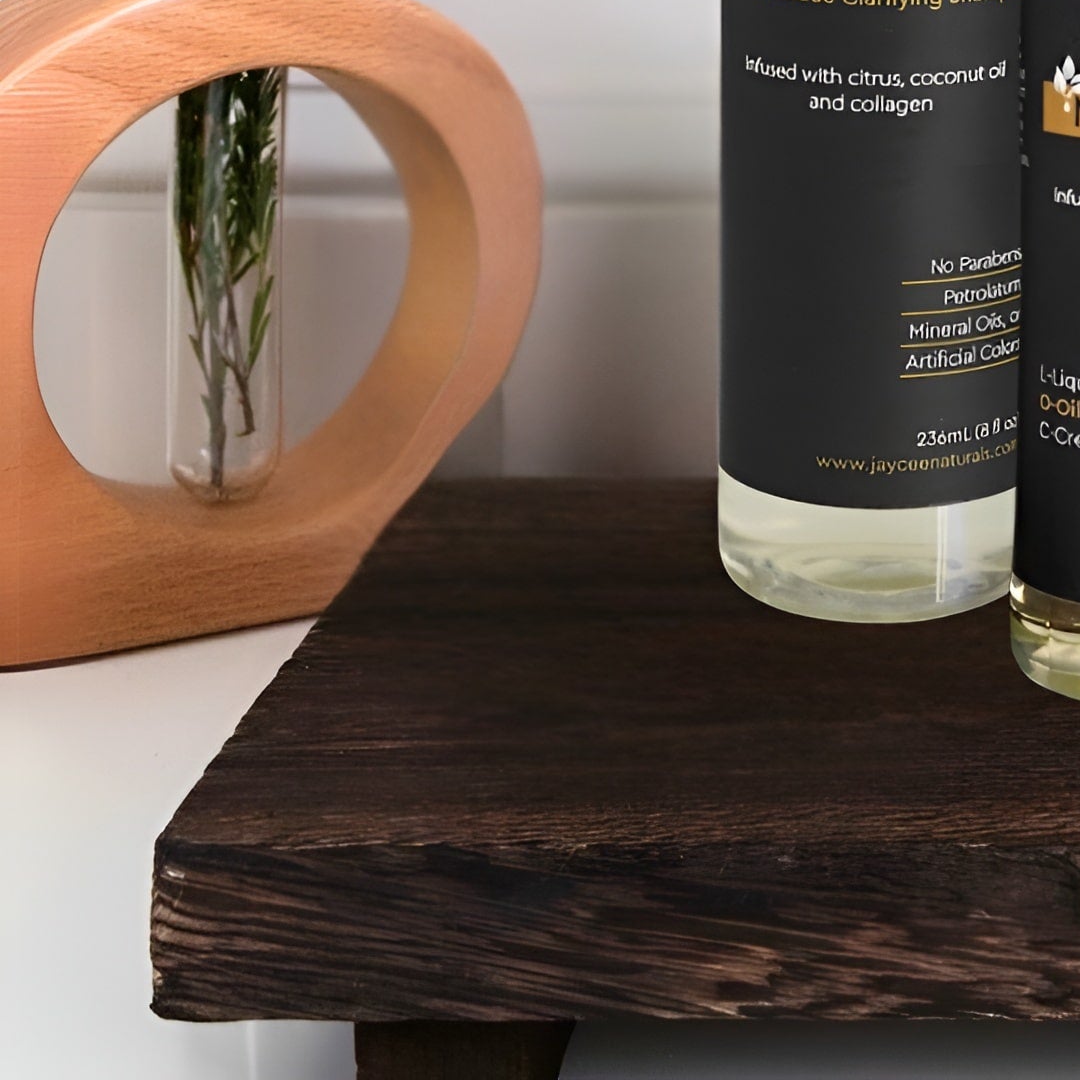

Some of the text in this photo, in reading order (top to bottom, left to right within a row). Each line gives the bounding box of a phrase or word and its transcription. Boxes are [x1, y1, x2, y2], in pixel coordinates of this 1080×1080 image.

[745, 54, 1006, 88] Infused with citrus, coconut oil
[809, 94, 933, 116] and collagen
[931, 258, 954, 274] No
[909, 317, 971, 340] Mineral
[905, 347, 976, 370] Artificial
[916, 427, 971, 447] 236mL
